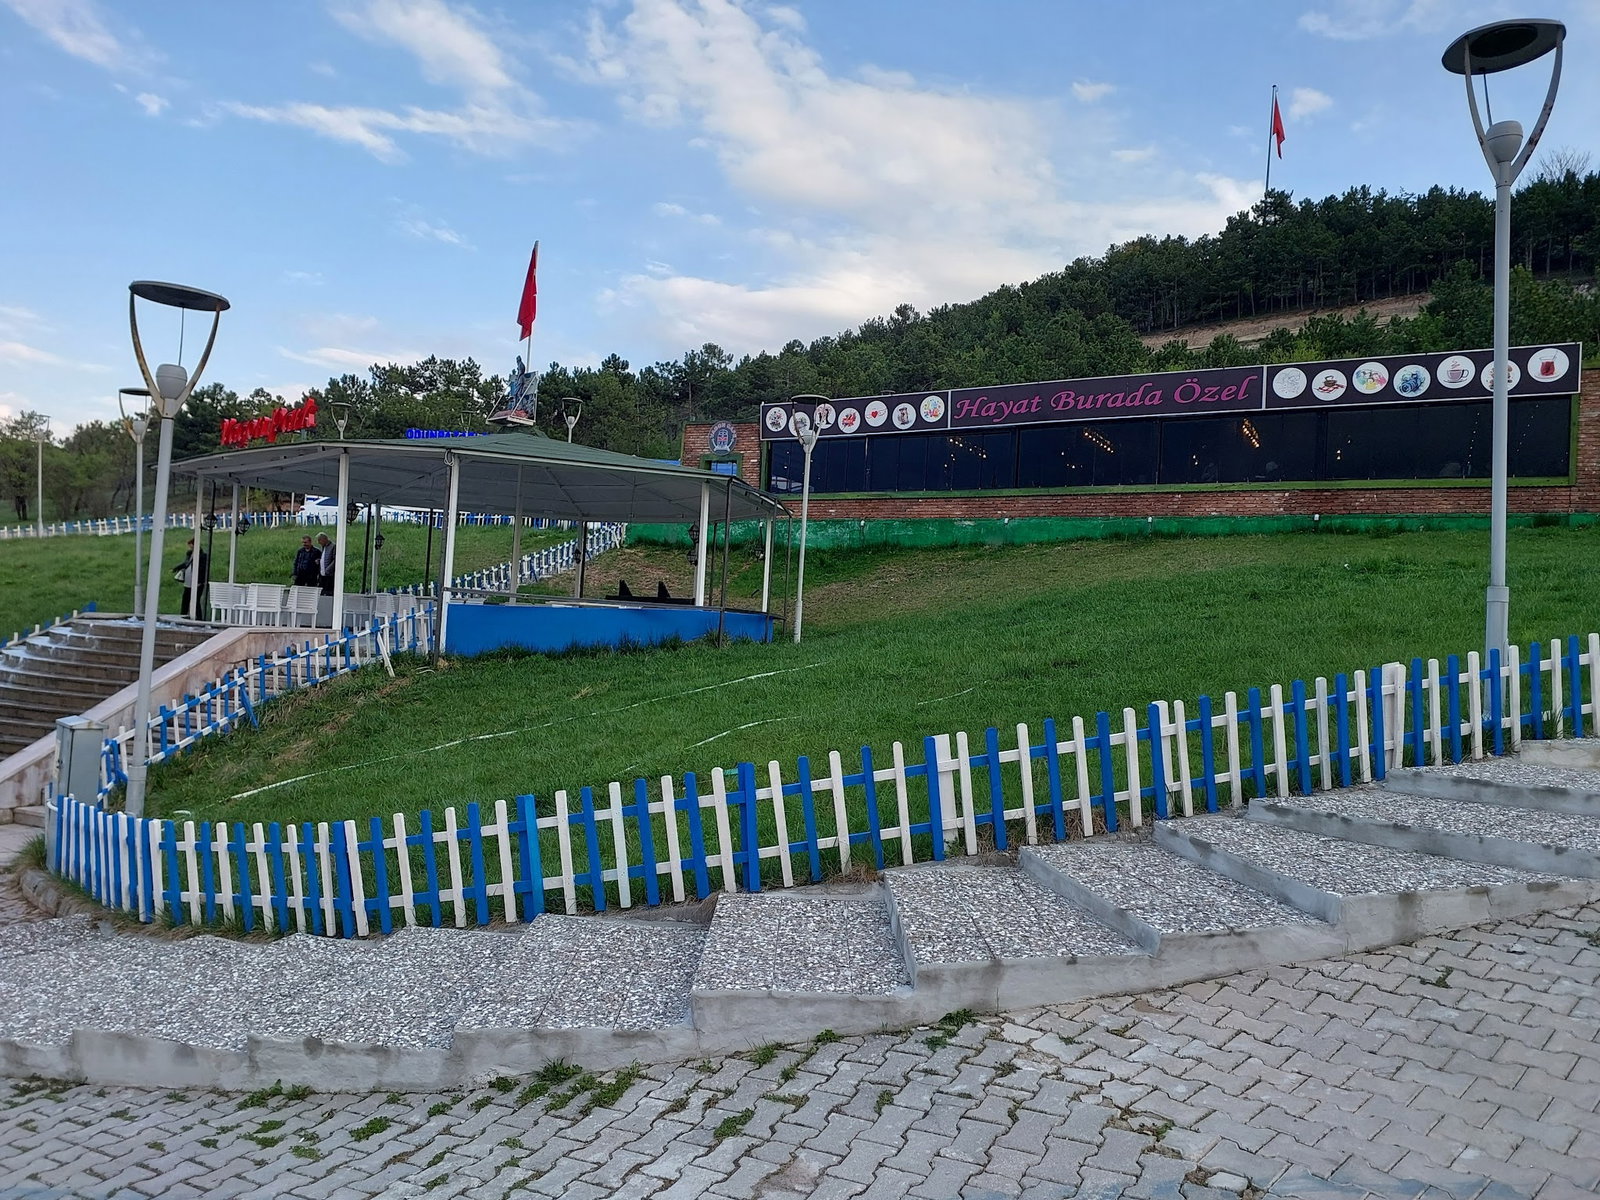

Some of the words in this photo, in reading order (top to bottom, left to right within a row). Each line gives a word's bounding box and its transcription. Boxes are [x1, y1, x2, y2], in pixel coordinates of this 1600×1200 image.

[953, 395, 1042, 423] Hayat
[1050, 383, 1163, 411] Burada
[1174, 375, 1259, 404] Özel
